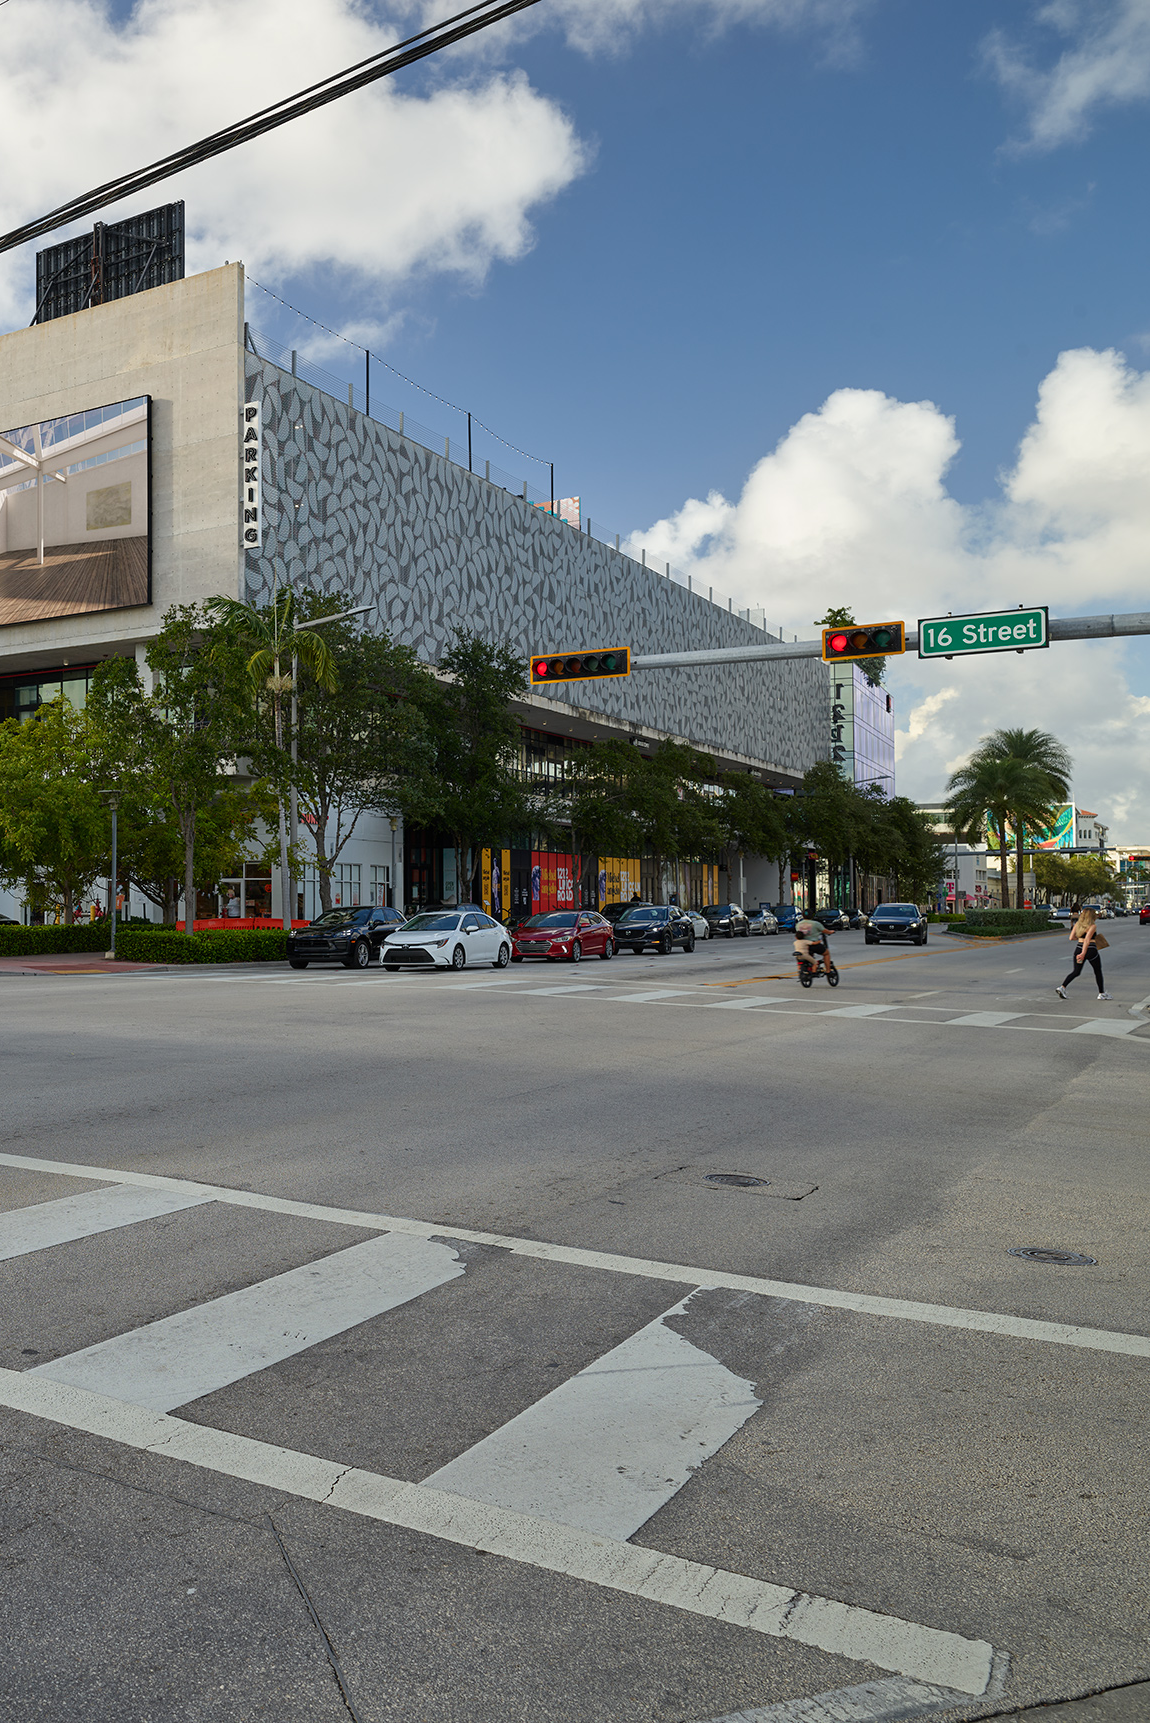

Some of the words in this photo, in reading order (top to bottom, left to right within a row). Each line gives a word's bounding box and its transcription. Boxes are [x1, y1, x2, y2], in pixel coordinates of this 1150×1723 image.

[243, 407, 258, 543] PARKING
[927, 627, 953, 648] 16
[962, 618, 1037, 645] Street
